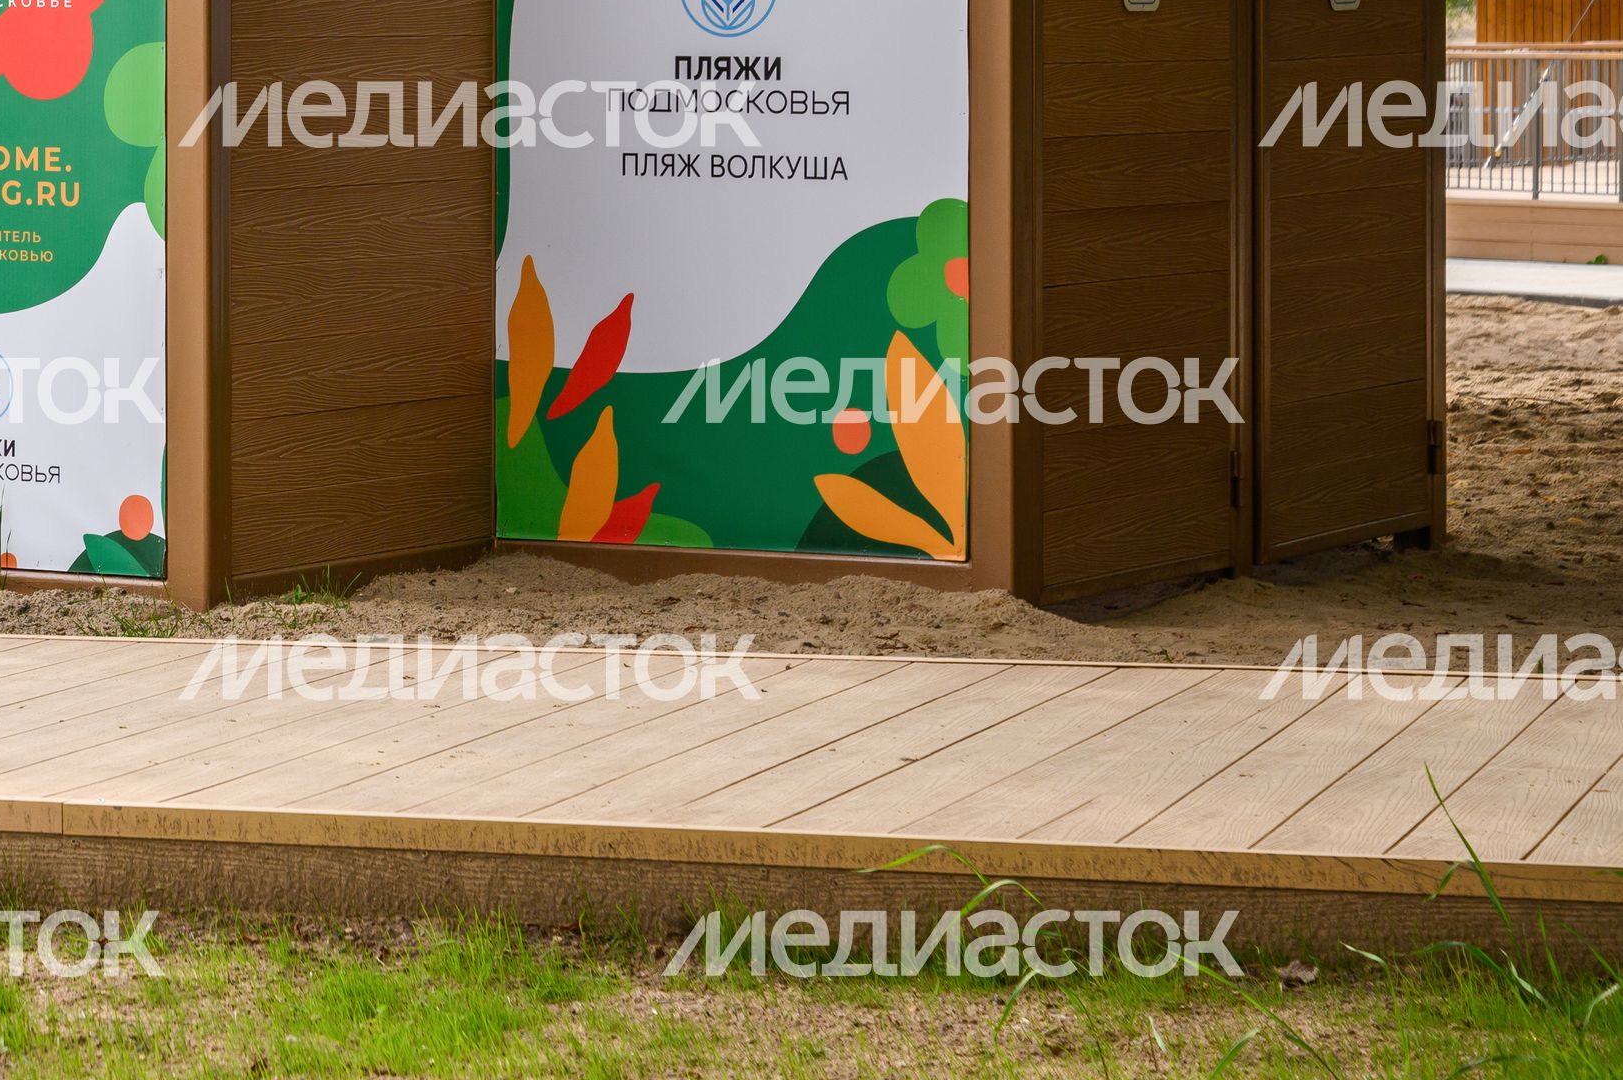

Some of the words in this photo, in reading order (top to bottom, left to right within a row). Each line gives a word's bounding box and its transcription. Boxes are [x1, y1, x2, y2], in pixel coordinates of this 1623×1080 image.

[674, 56, 781, 81] ПЛЯЖИ
[608, 88, 850, 115] ПОДМОСКОВЬЯ
[622, 153, 701, 177] ПЛЯЖ
[710, 154, 848, 180] ВОЛКУША
